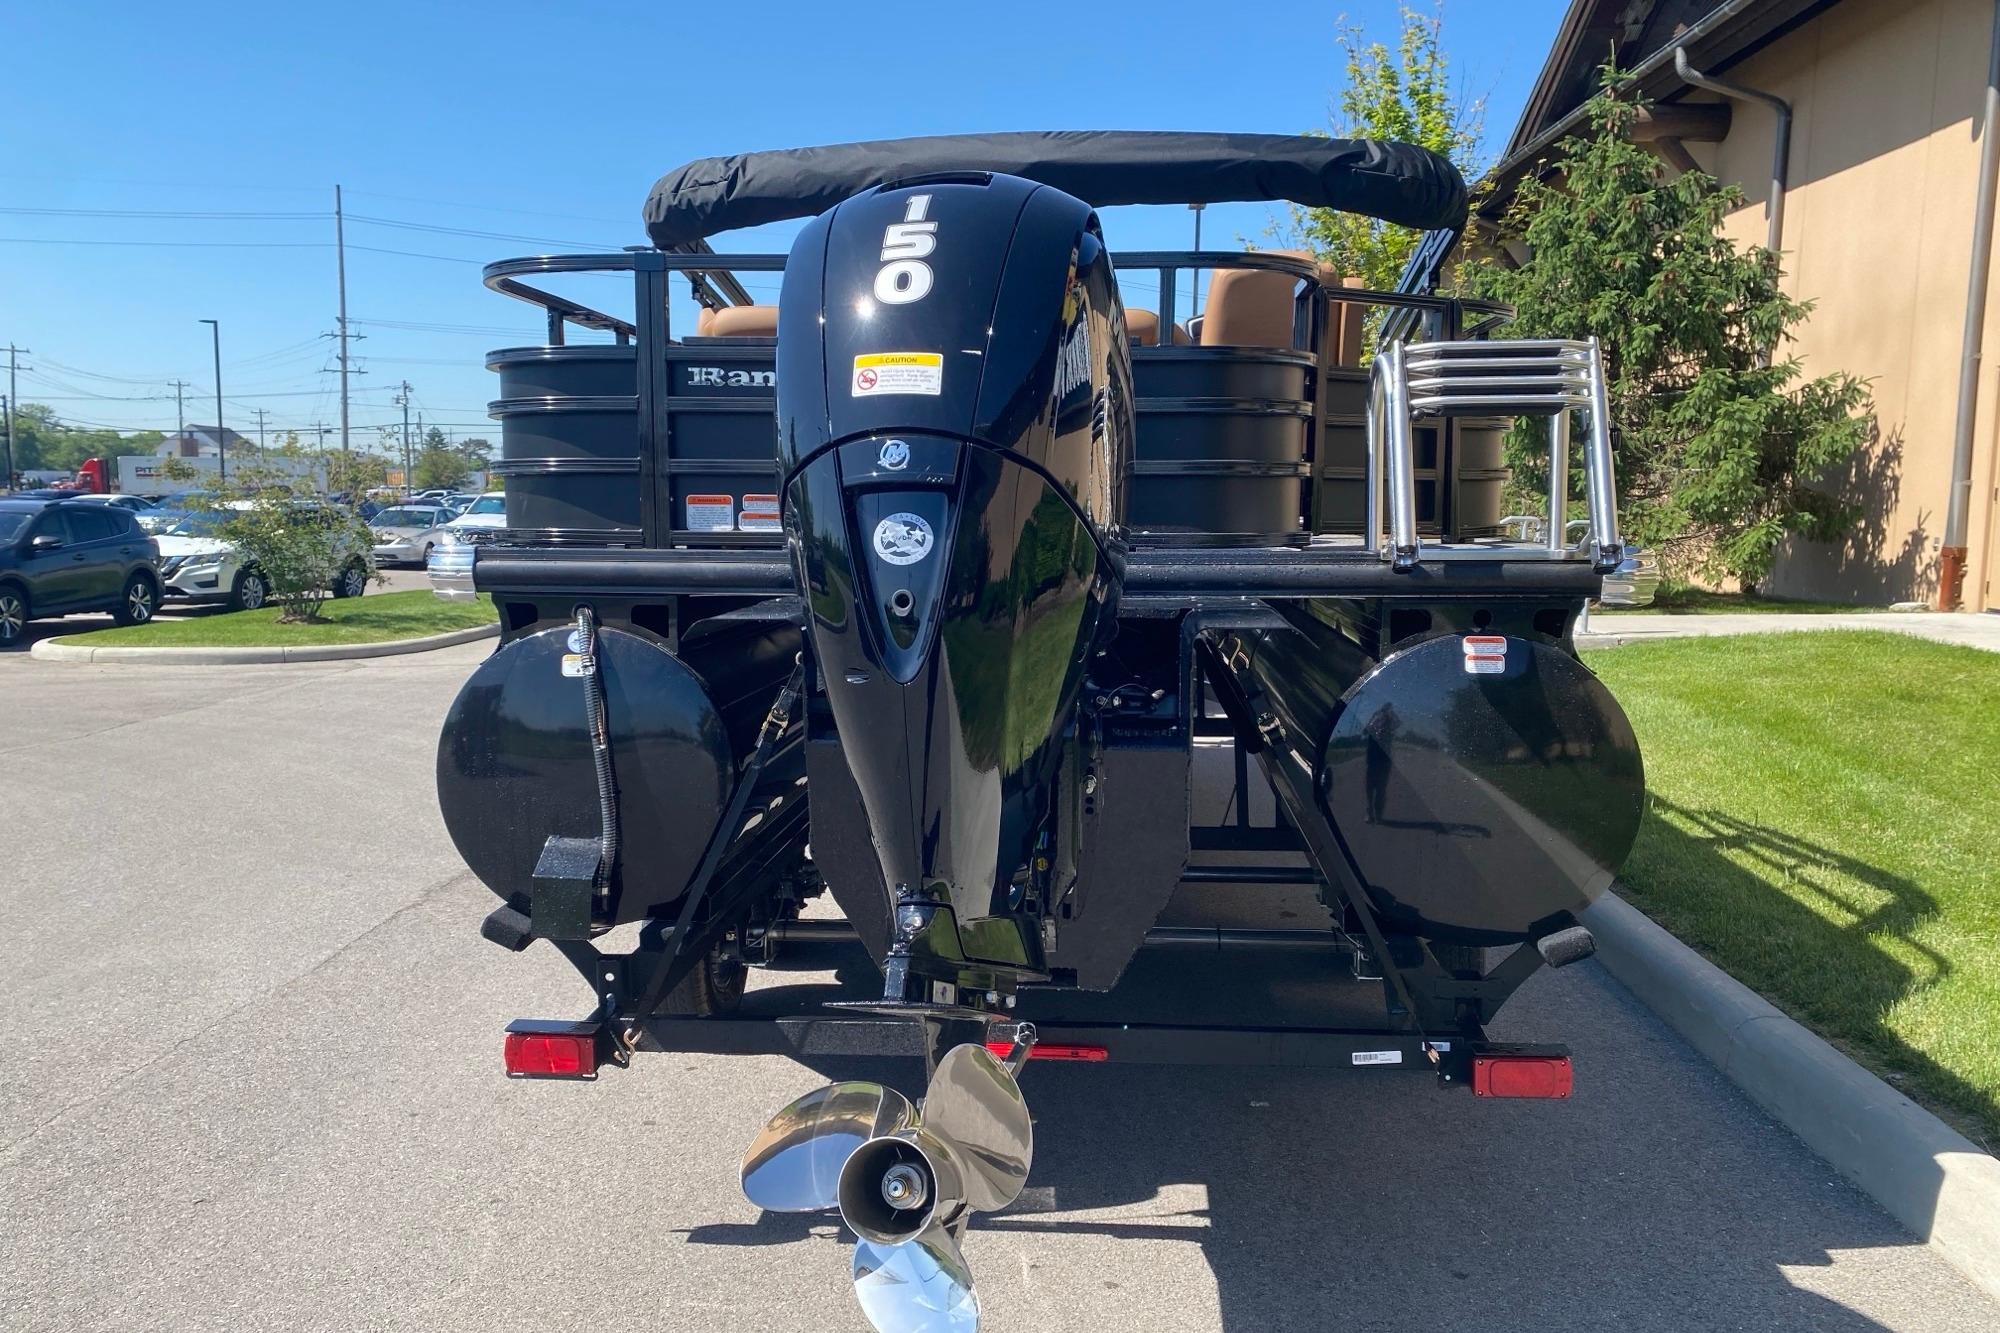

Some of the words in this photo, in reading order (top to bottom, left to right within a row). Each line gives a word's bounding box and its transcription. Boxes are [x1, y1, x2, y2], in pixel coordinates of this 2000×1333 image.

[874, 194, 939, 305] 150
[885, 356, 918, 364] CAUTION
[910, 515, 928, 528] LOW
